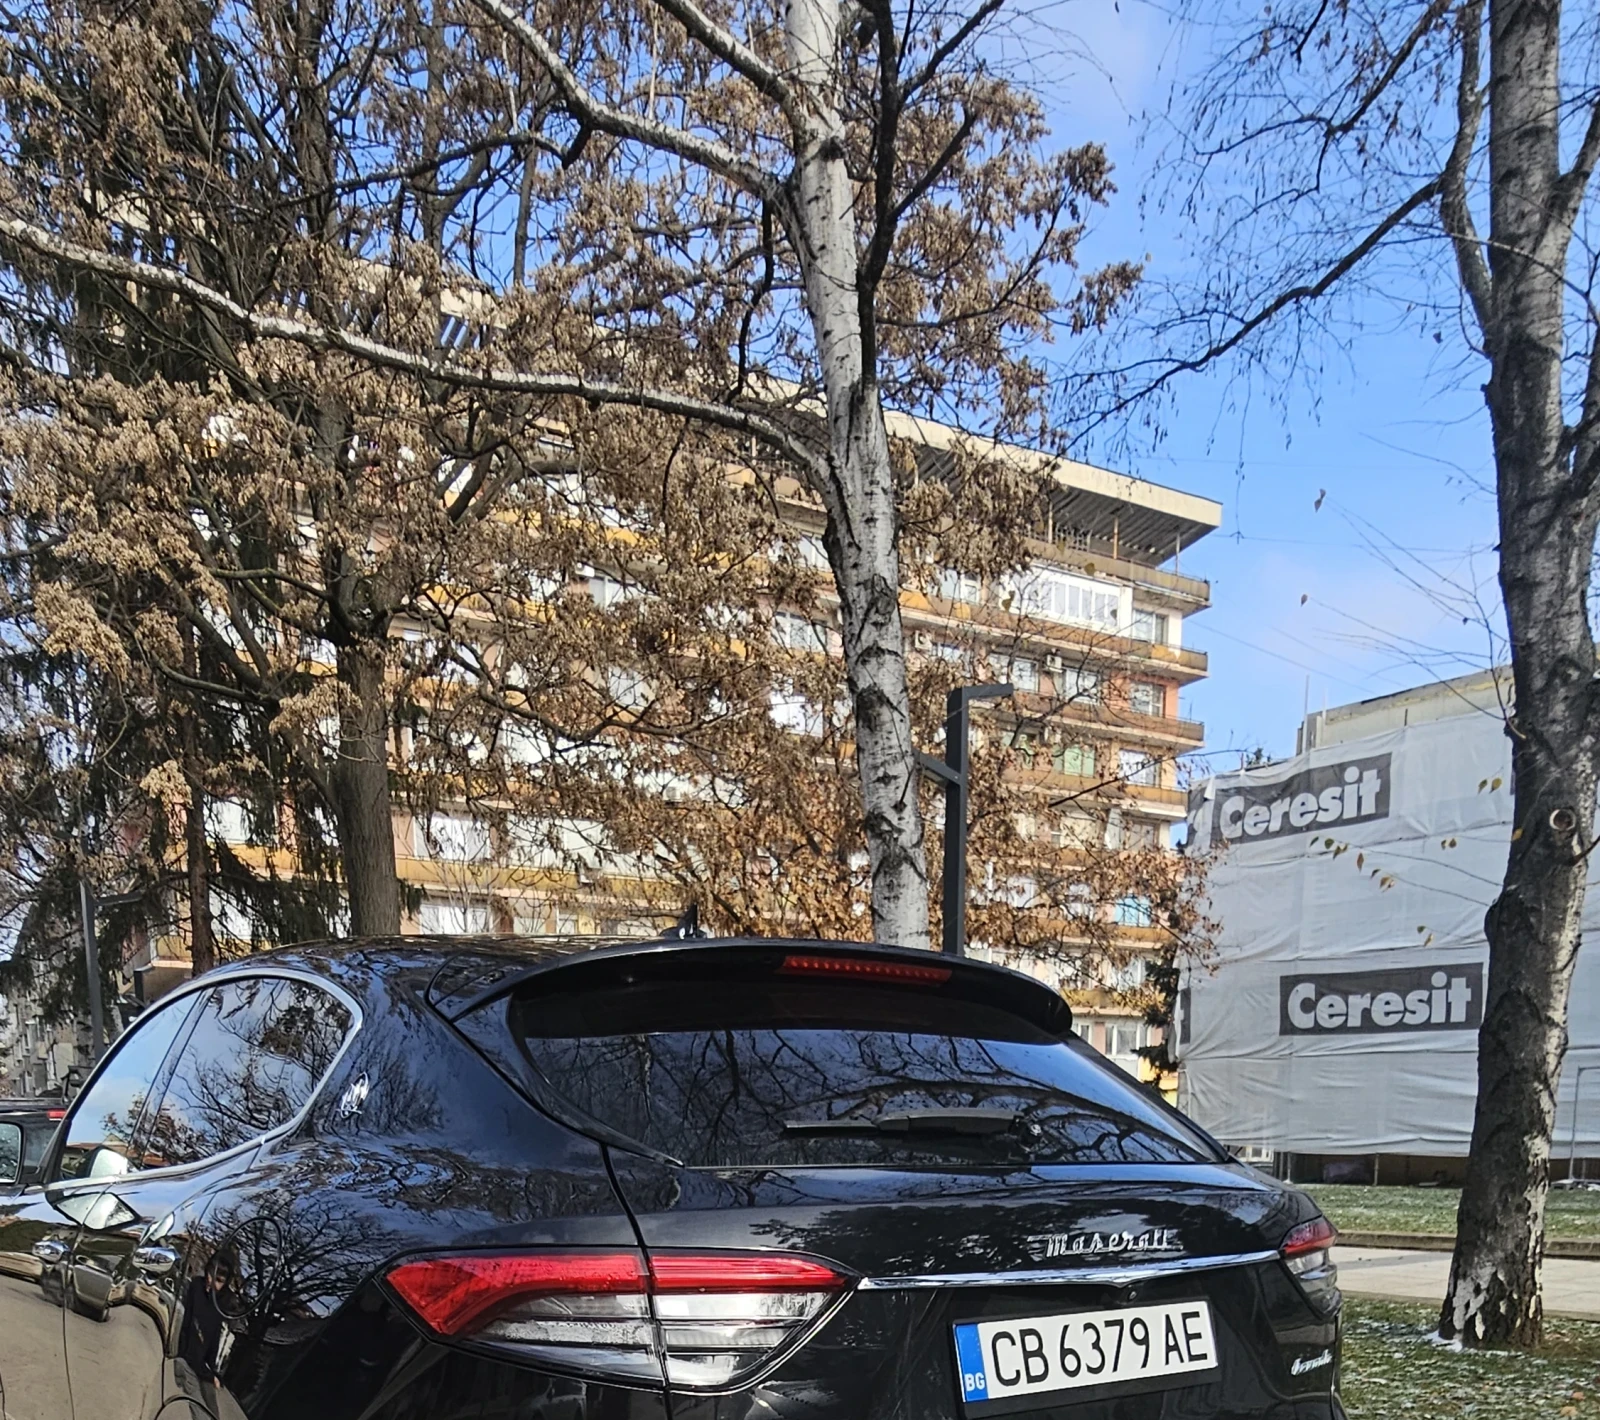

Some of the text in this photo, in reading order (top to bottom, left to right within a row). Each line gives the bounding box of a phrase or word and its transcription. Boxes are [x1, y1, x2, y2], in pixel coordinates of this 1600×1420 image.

[1220, 766, 1381, 838] Ceresit
[1288, 972, 1471, 1029] Ceresit
[991, 1311, 1208, 1387] CB 6379 AE
[964, 1372, 985, 1392] BG
